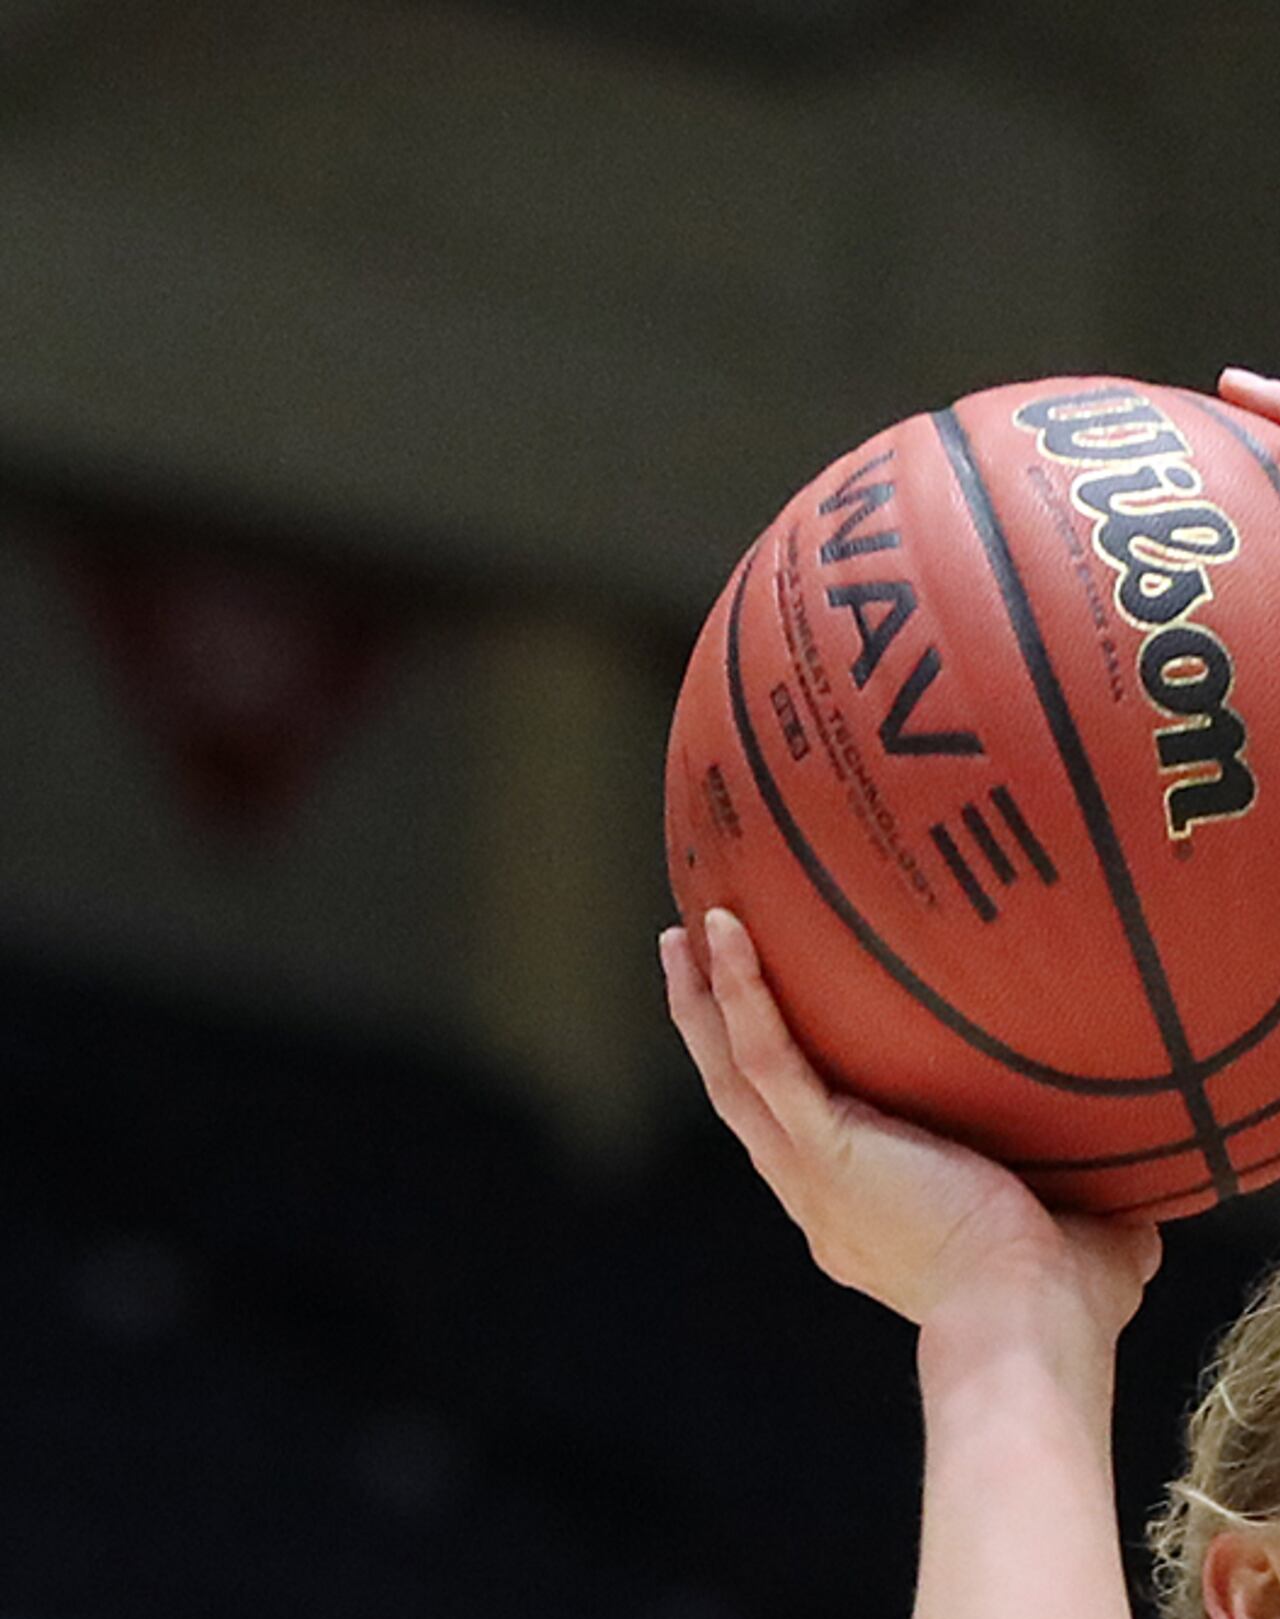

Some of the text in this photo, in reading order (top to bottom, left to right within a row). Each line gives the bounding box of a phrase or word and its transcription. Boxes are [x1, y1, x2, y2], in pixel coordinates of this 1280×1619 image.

[818, 448, 1058, 924] WAVE
[828, 707, 937, 906] TECHNOLOGY
[1013, 386, 1257, 840] Wilson
